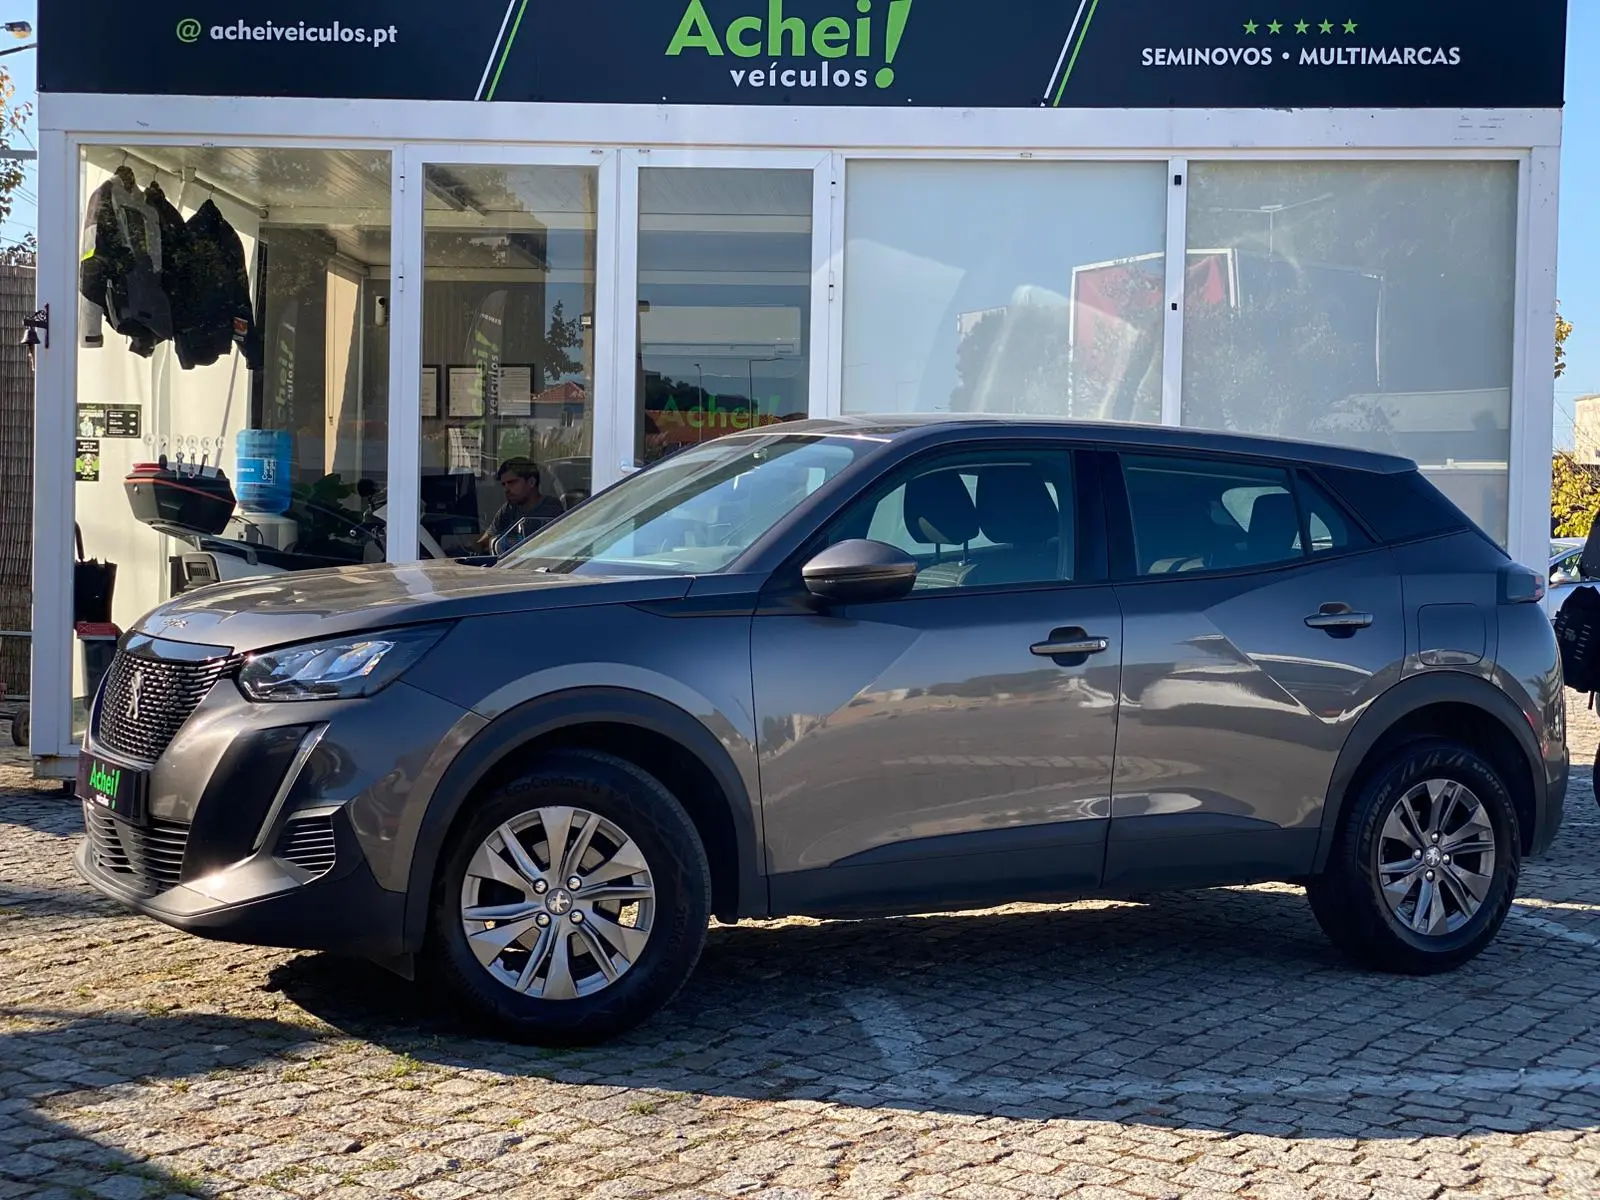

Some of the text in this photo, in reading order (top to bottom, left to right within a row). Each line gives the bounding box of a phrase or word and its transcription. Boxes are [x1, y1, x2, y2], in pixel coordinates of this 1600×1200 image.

[210, 19, 398, 47] acheiveiculos.pt
[665, 0, 912, 88] Achei!
[1141, 46, 1461, 66] SEMINOVOS MULTIMARCAS
[730, 61, 868, 88] veículos
[89, 759, 121, 810] Achei!
